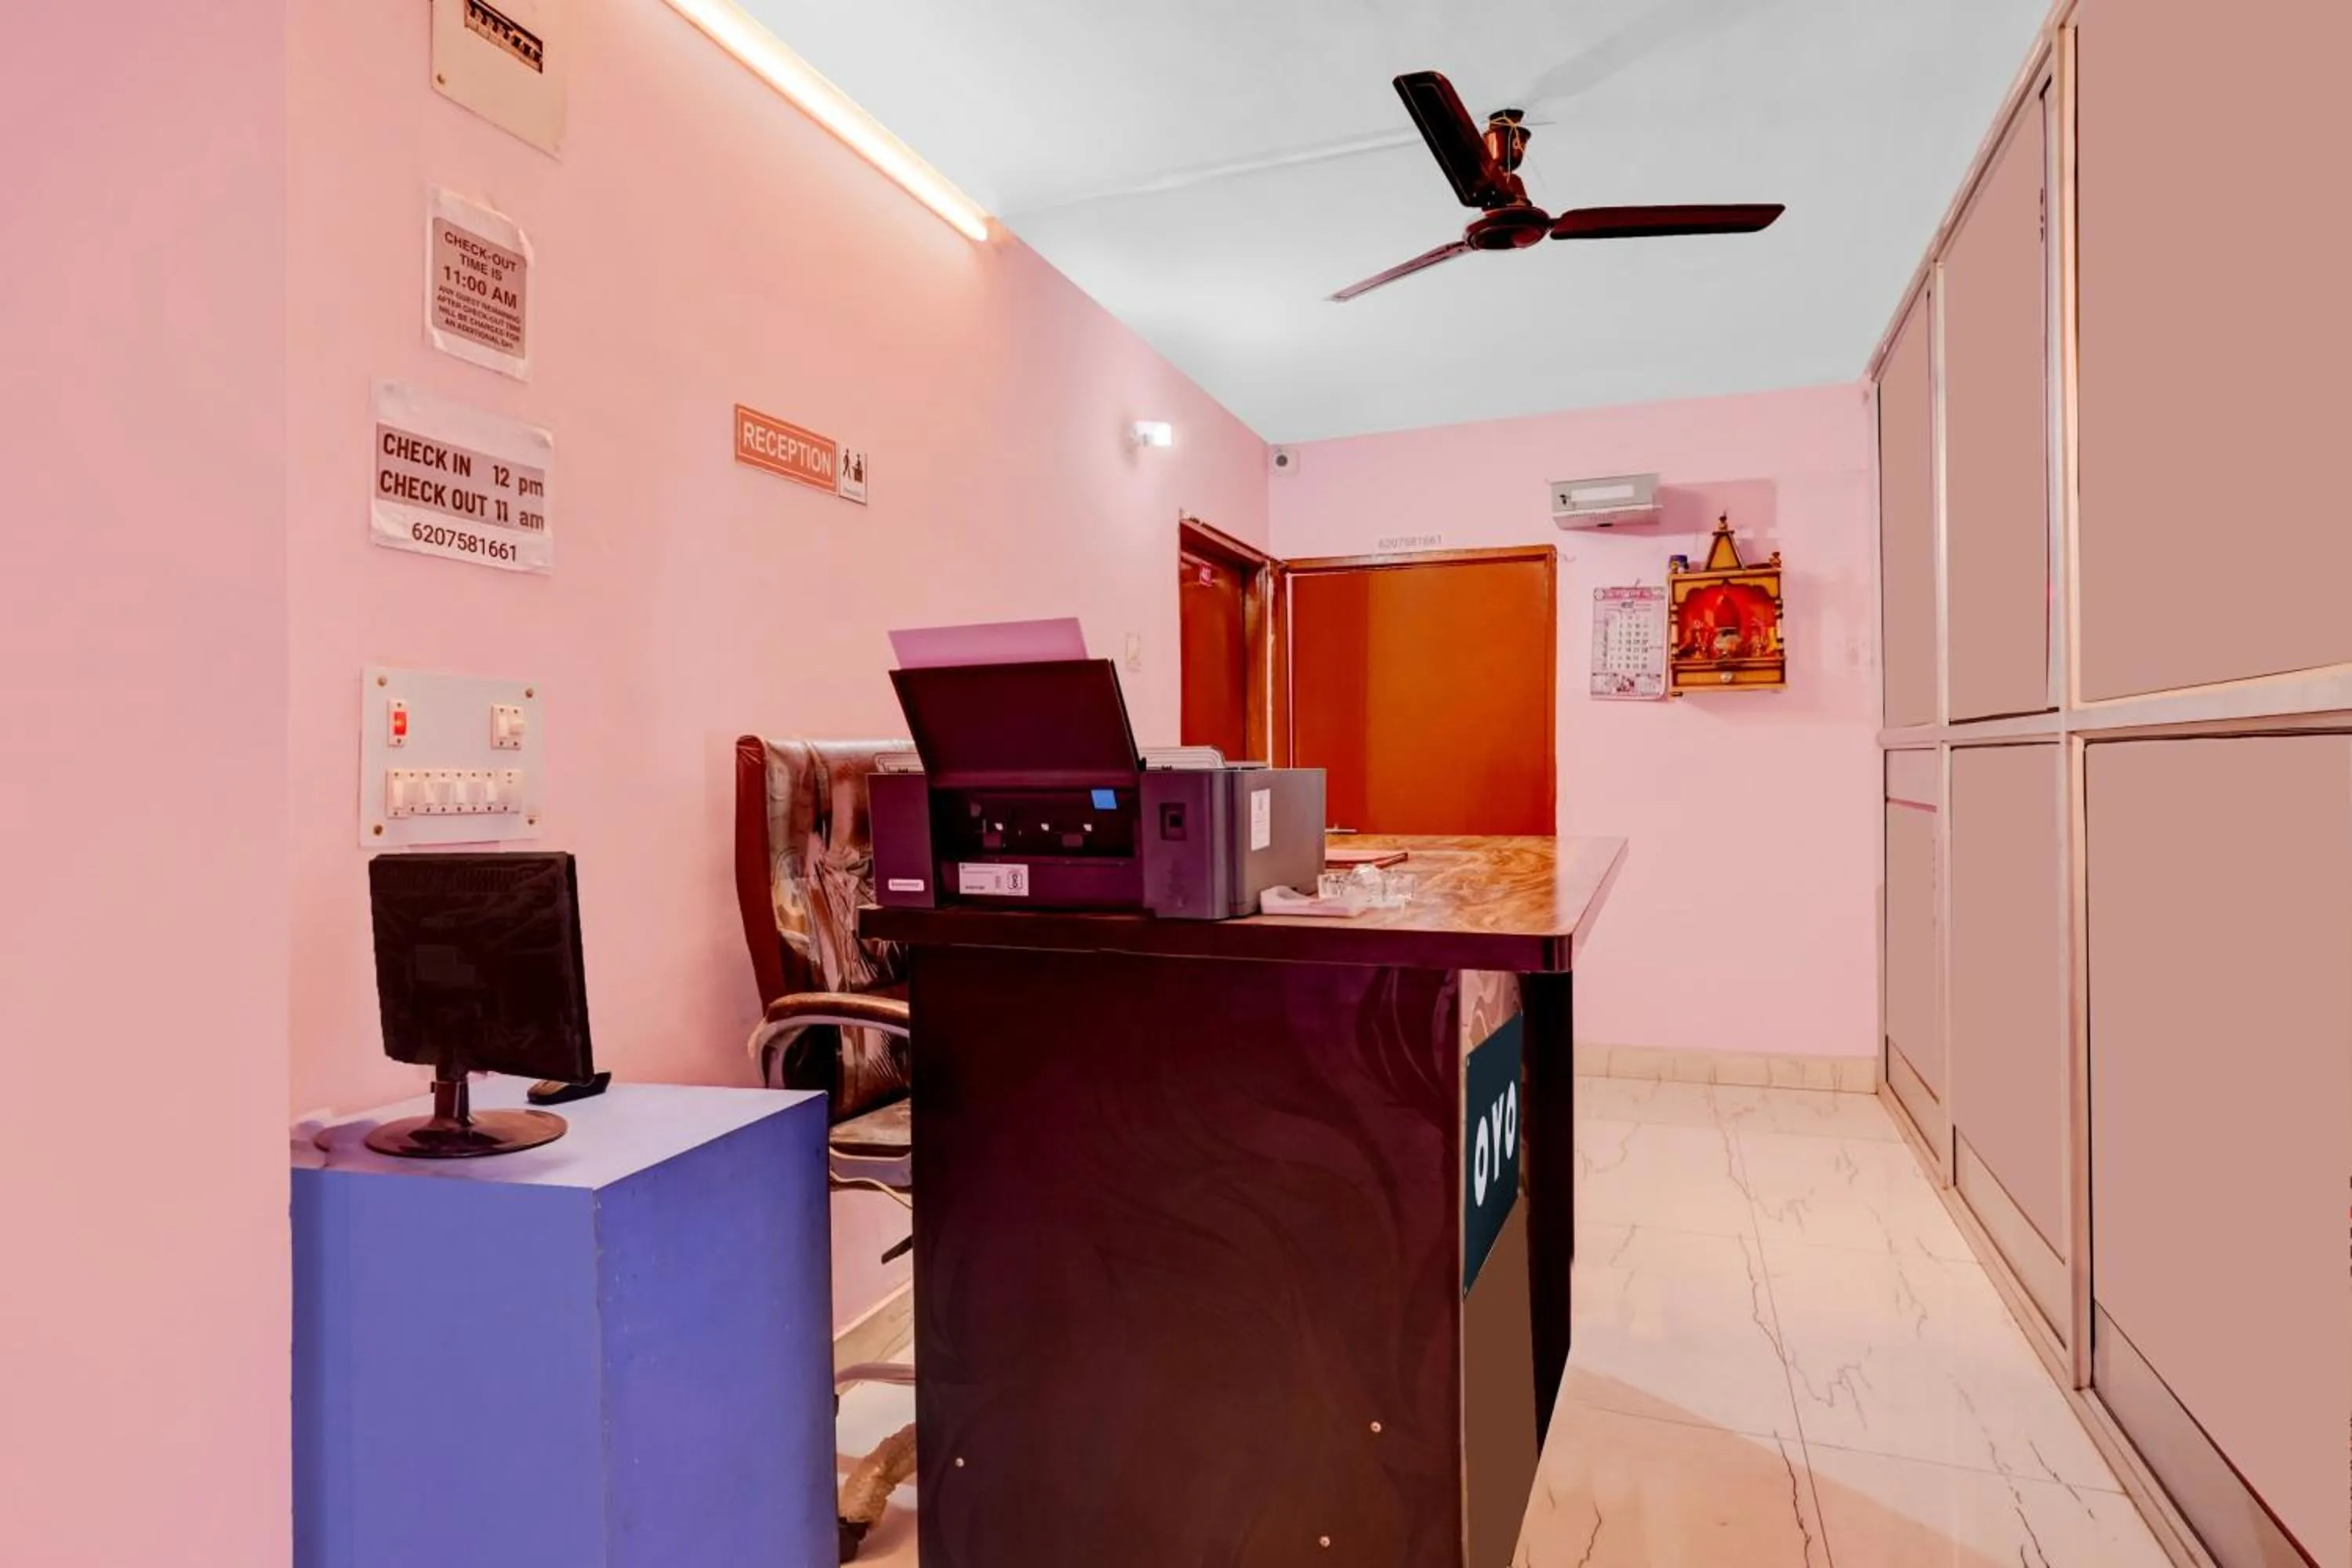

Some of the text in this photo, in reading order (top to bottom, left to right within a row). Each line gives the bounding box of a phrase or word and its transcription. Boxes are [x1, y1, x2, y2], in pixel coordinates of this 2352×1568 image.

[445, 231, 517, 274] CHECK-OUT
[459, 253, 503, 281] TIME IS
[443, 266, 517, 309] 11:00 AM
[383, 433, 544, 497] CHECK IN 12 pm
[743, 421, 832, 477] RECEPTION
[379, 470, 544, 532] CHECK OUT 11 am
[412, 522, 517, 561] 6207581661
[1474, 1080, 1517, 1207] OYO
